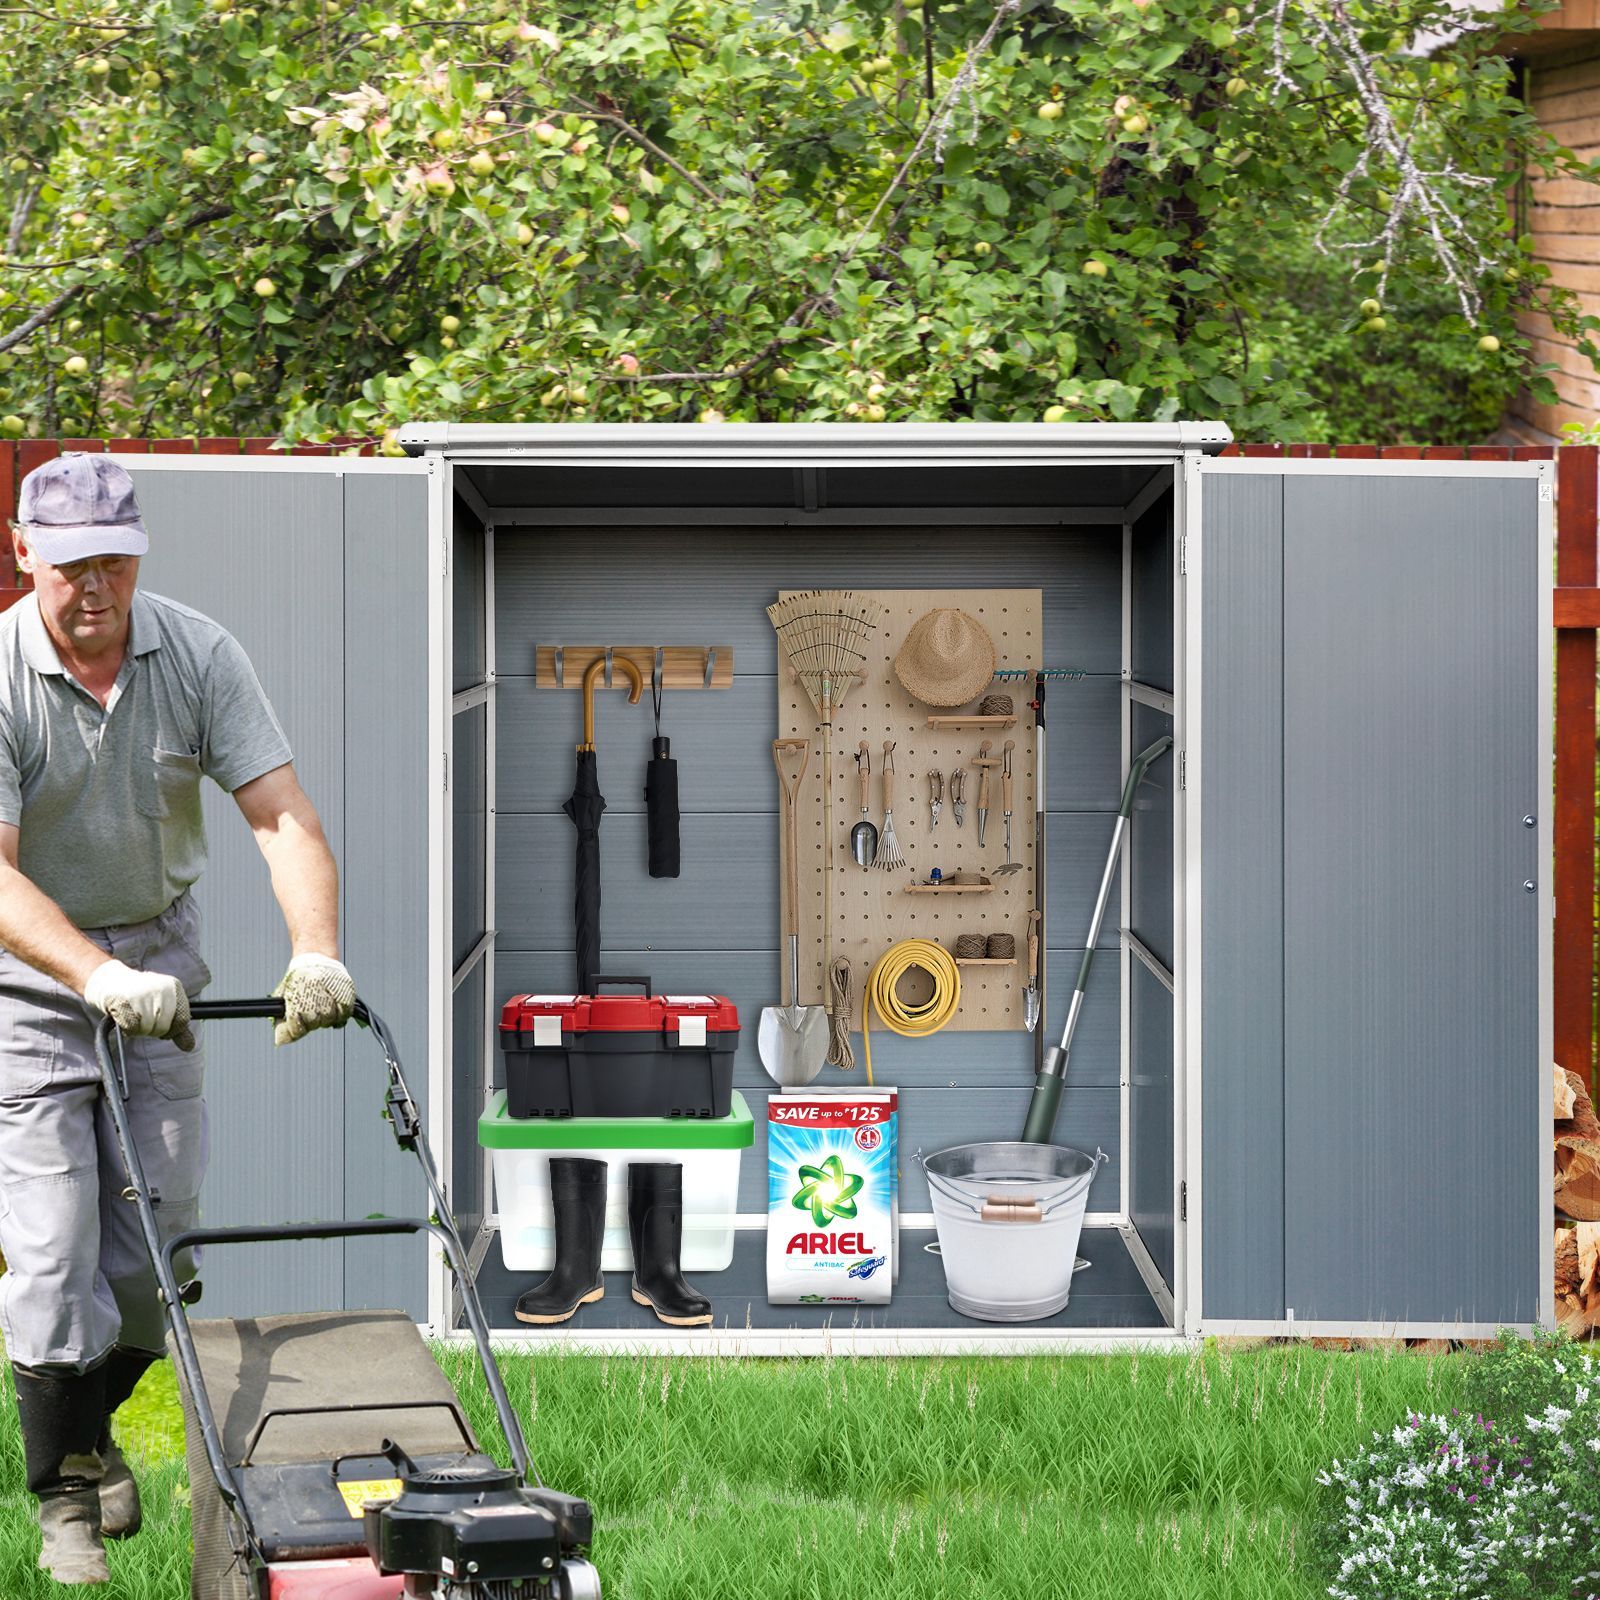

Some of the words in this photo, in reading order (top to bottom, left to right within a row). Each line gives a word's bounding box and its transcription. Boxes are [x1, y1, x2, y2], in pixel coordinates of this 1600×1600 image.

[775, 1107, 820, 1120] SAVE
[786, 1232, 873, 1254] ARIEL
[849, 1256, 886, 1277] Safeguard
